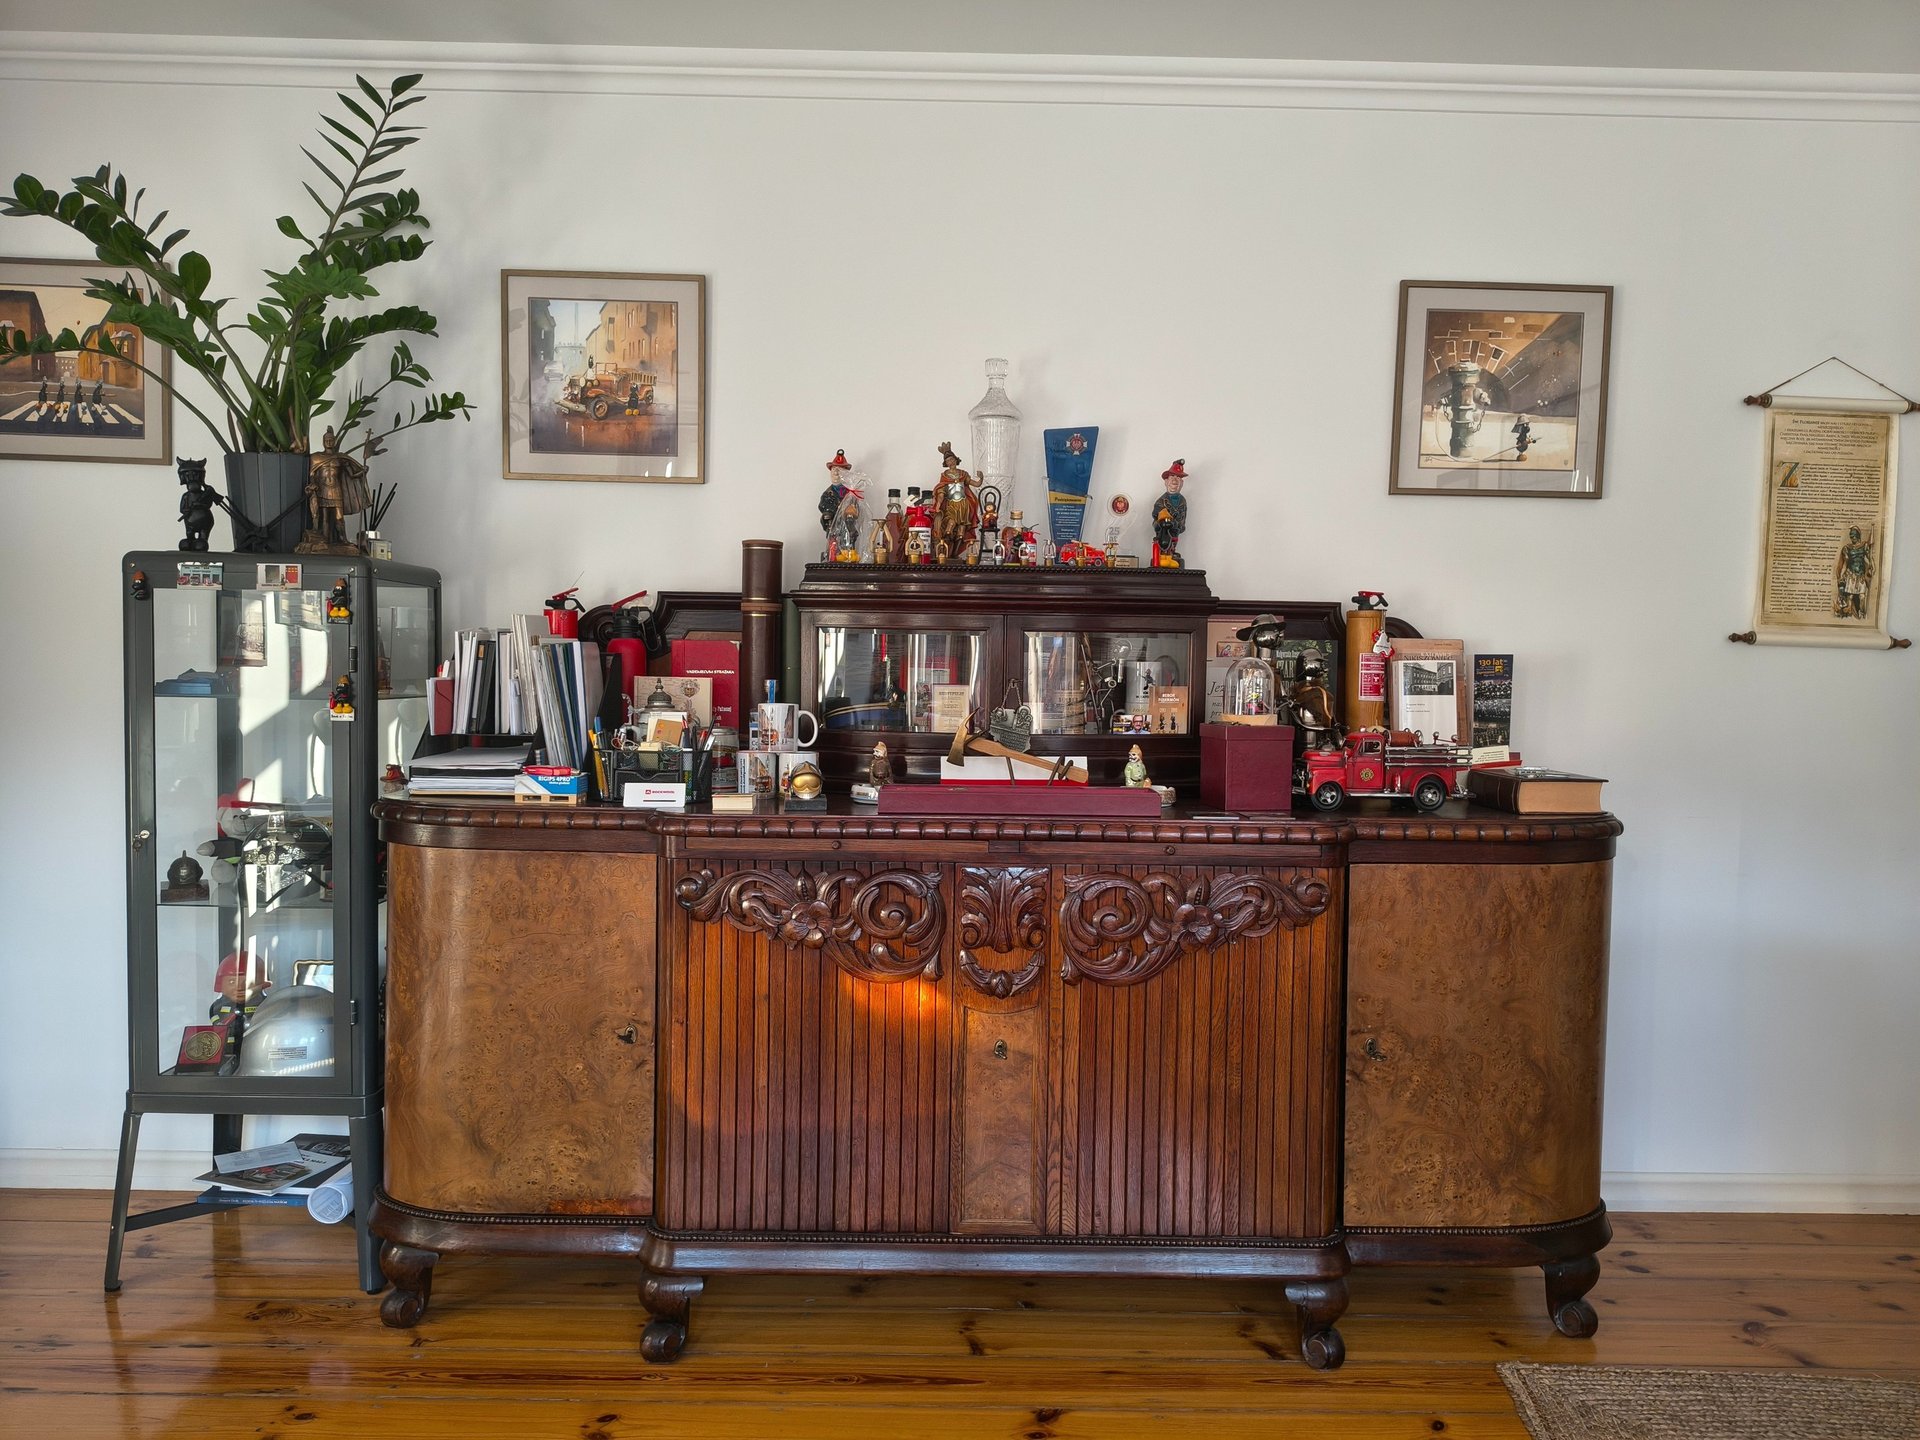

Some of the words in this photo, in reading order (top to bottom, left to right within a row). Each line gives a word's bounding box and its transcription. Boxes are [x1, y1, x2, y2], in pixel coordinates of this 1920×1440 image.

[1108, 526, 1120, 536] 25
[1478, 659, 1491, 667] 130
[1492, 657, 1504, 667] lat
